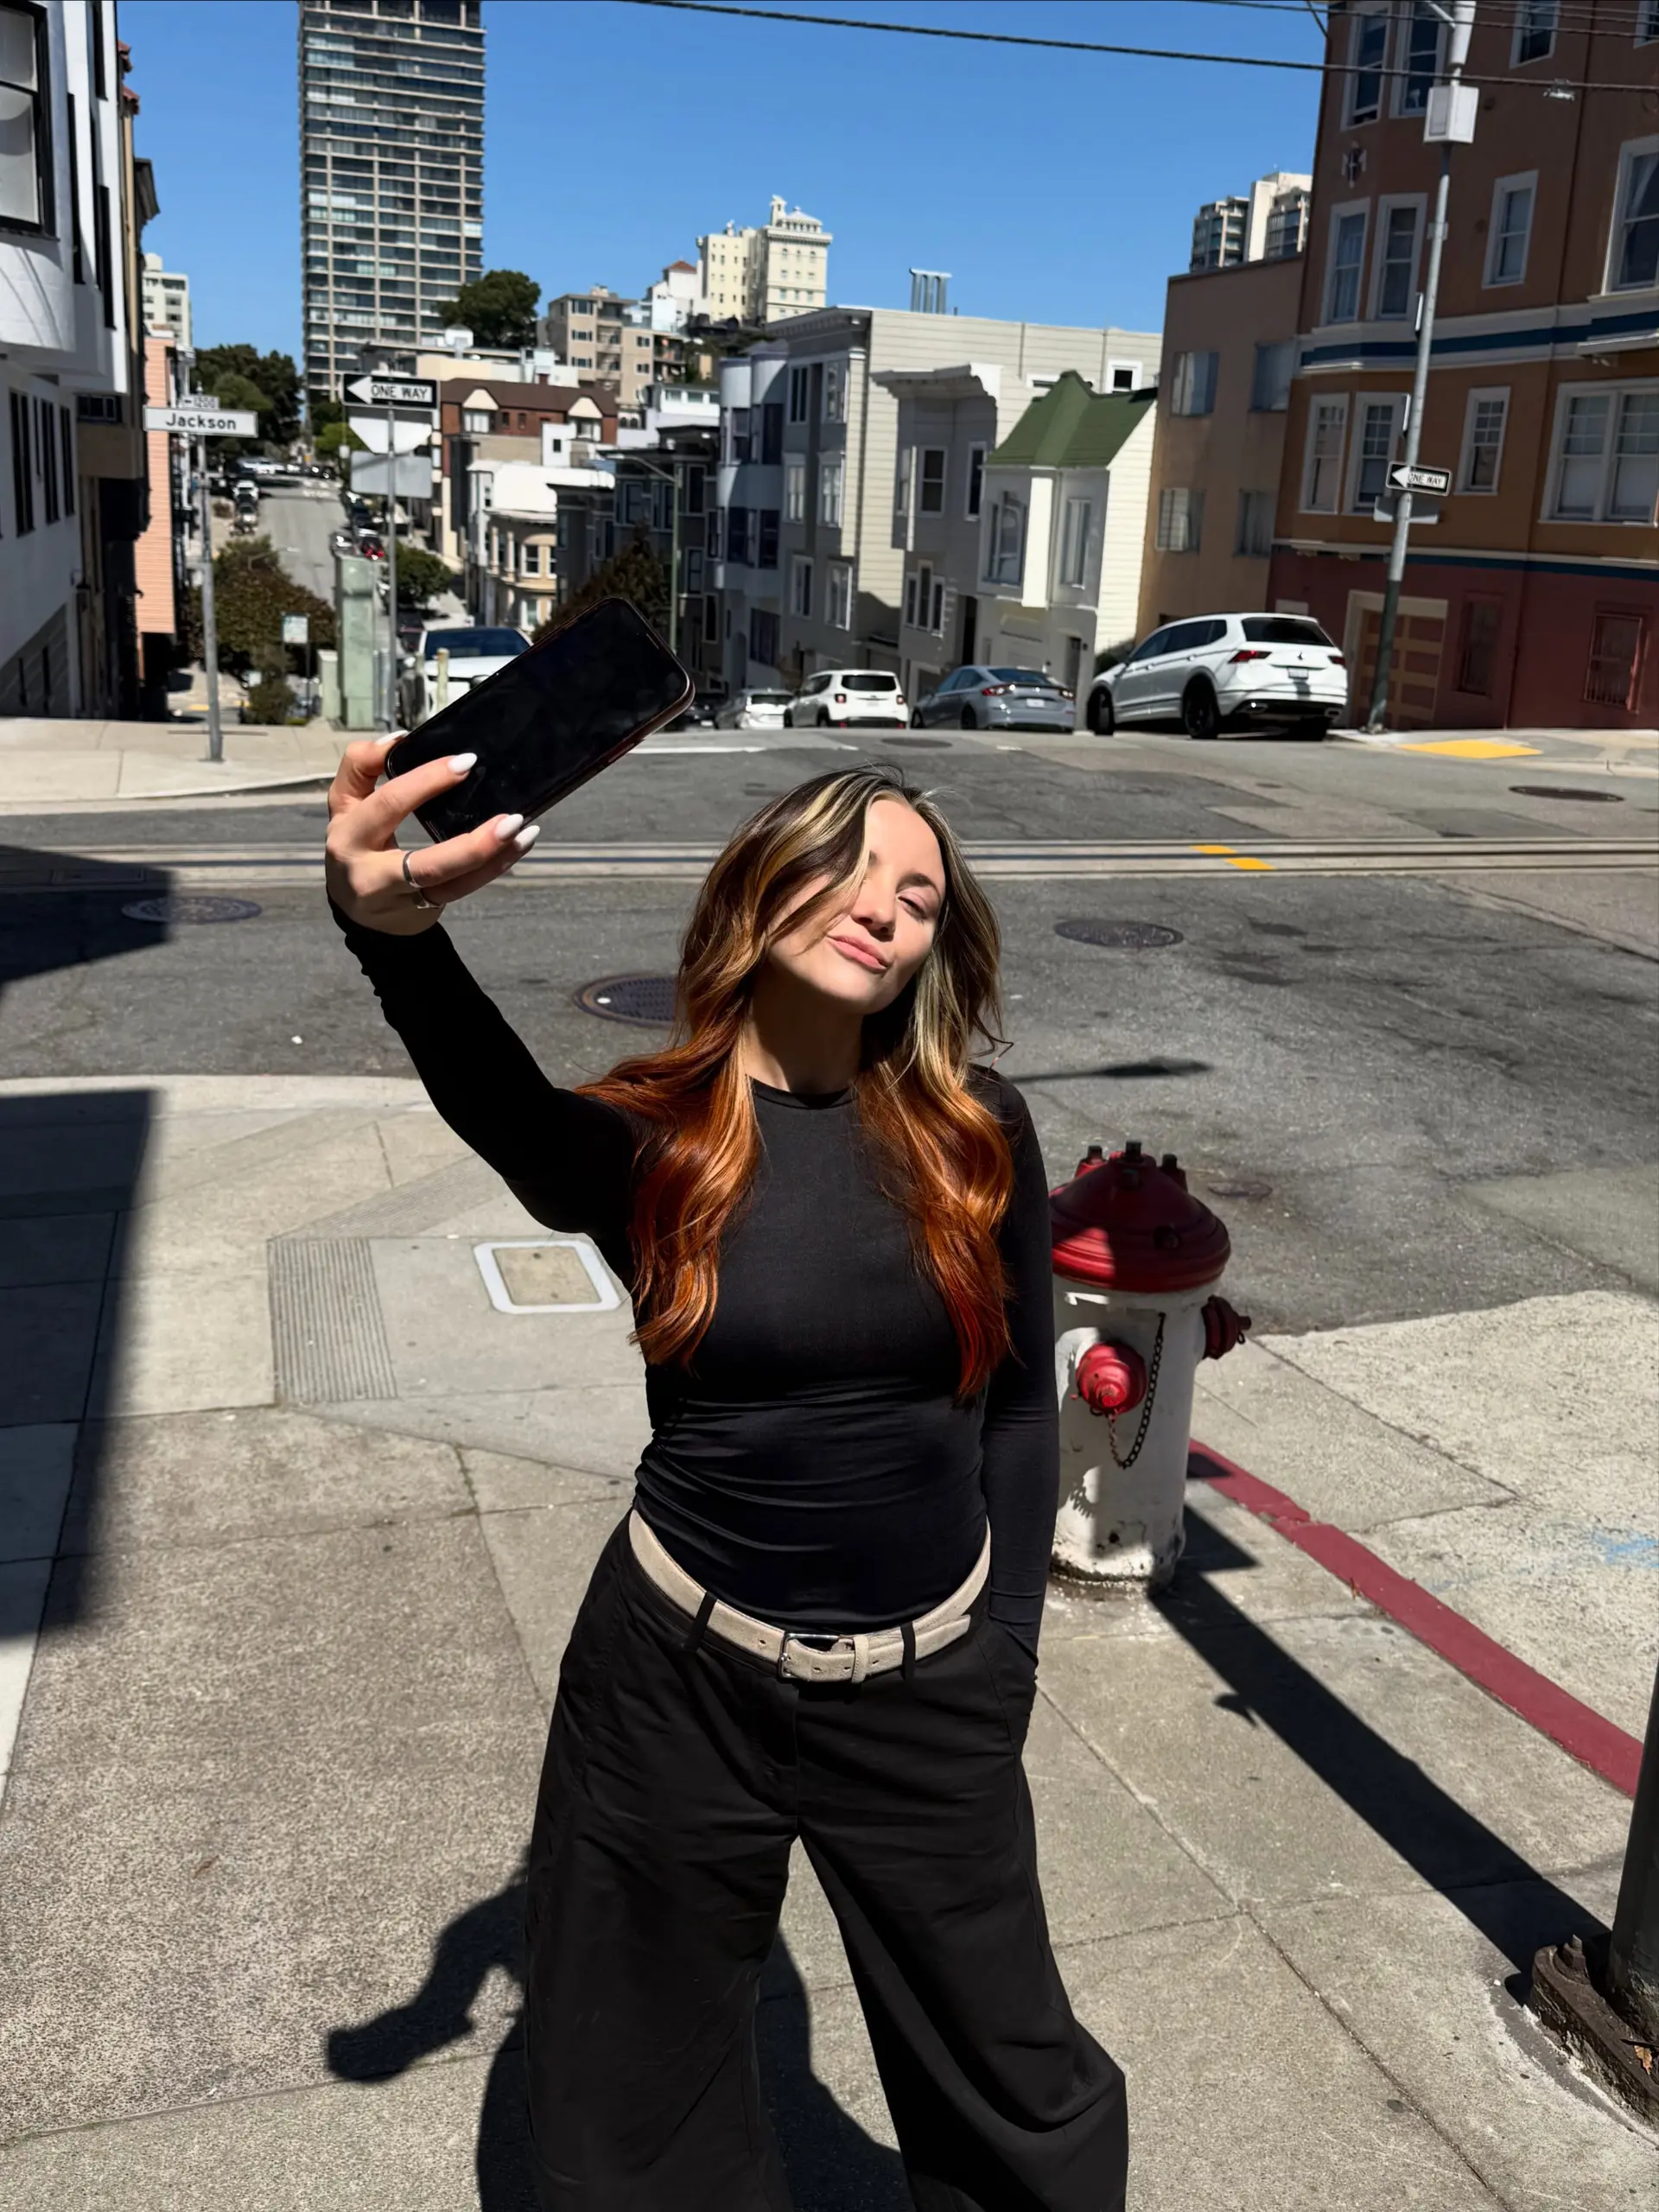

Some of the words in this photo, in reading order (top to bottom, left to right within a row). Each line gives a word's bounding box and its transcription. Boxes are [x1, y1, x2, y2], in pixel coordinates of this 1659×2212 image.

[371, 385, 397, 397] ONE
[401, 387, 428, 399] WAY
[166, 412, 237, 430] Jackson
[1408, 473, 1424, 484] ONE
[1427, 476, 1441, 486] WAY
